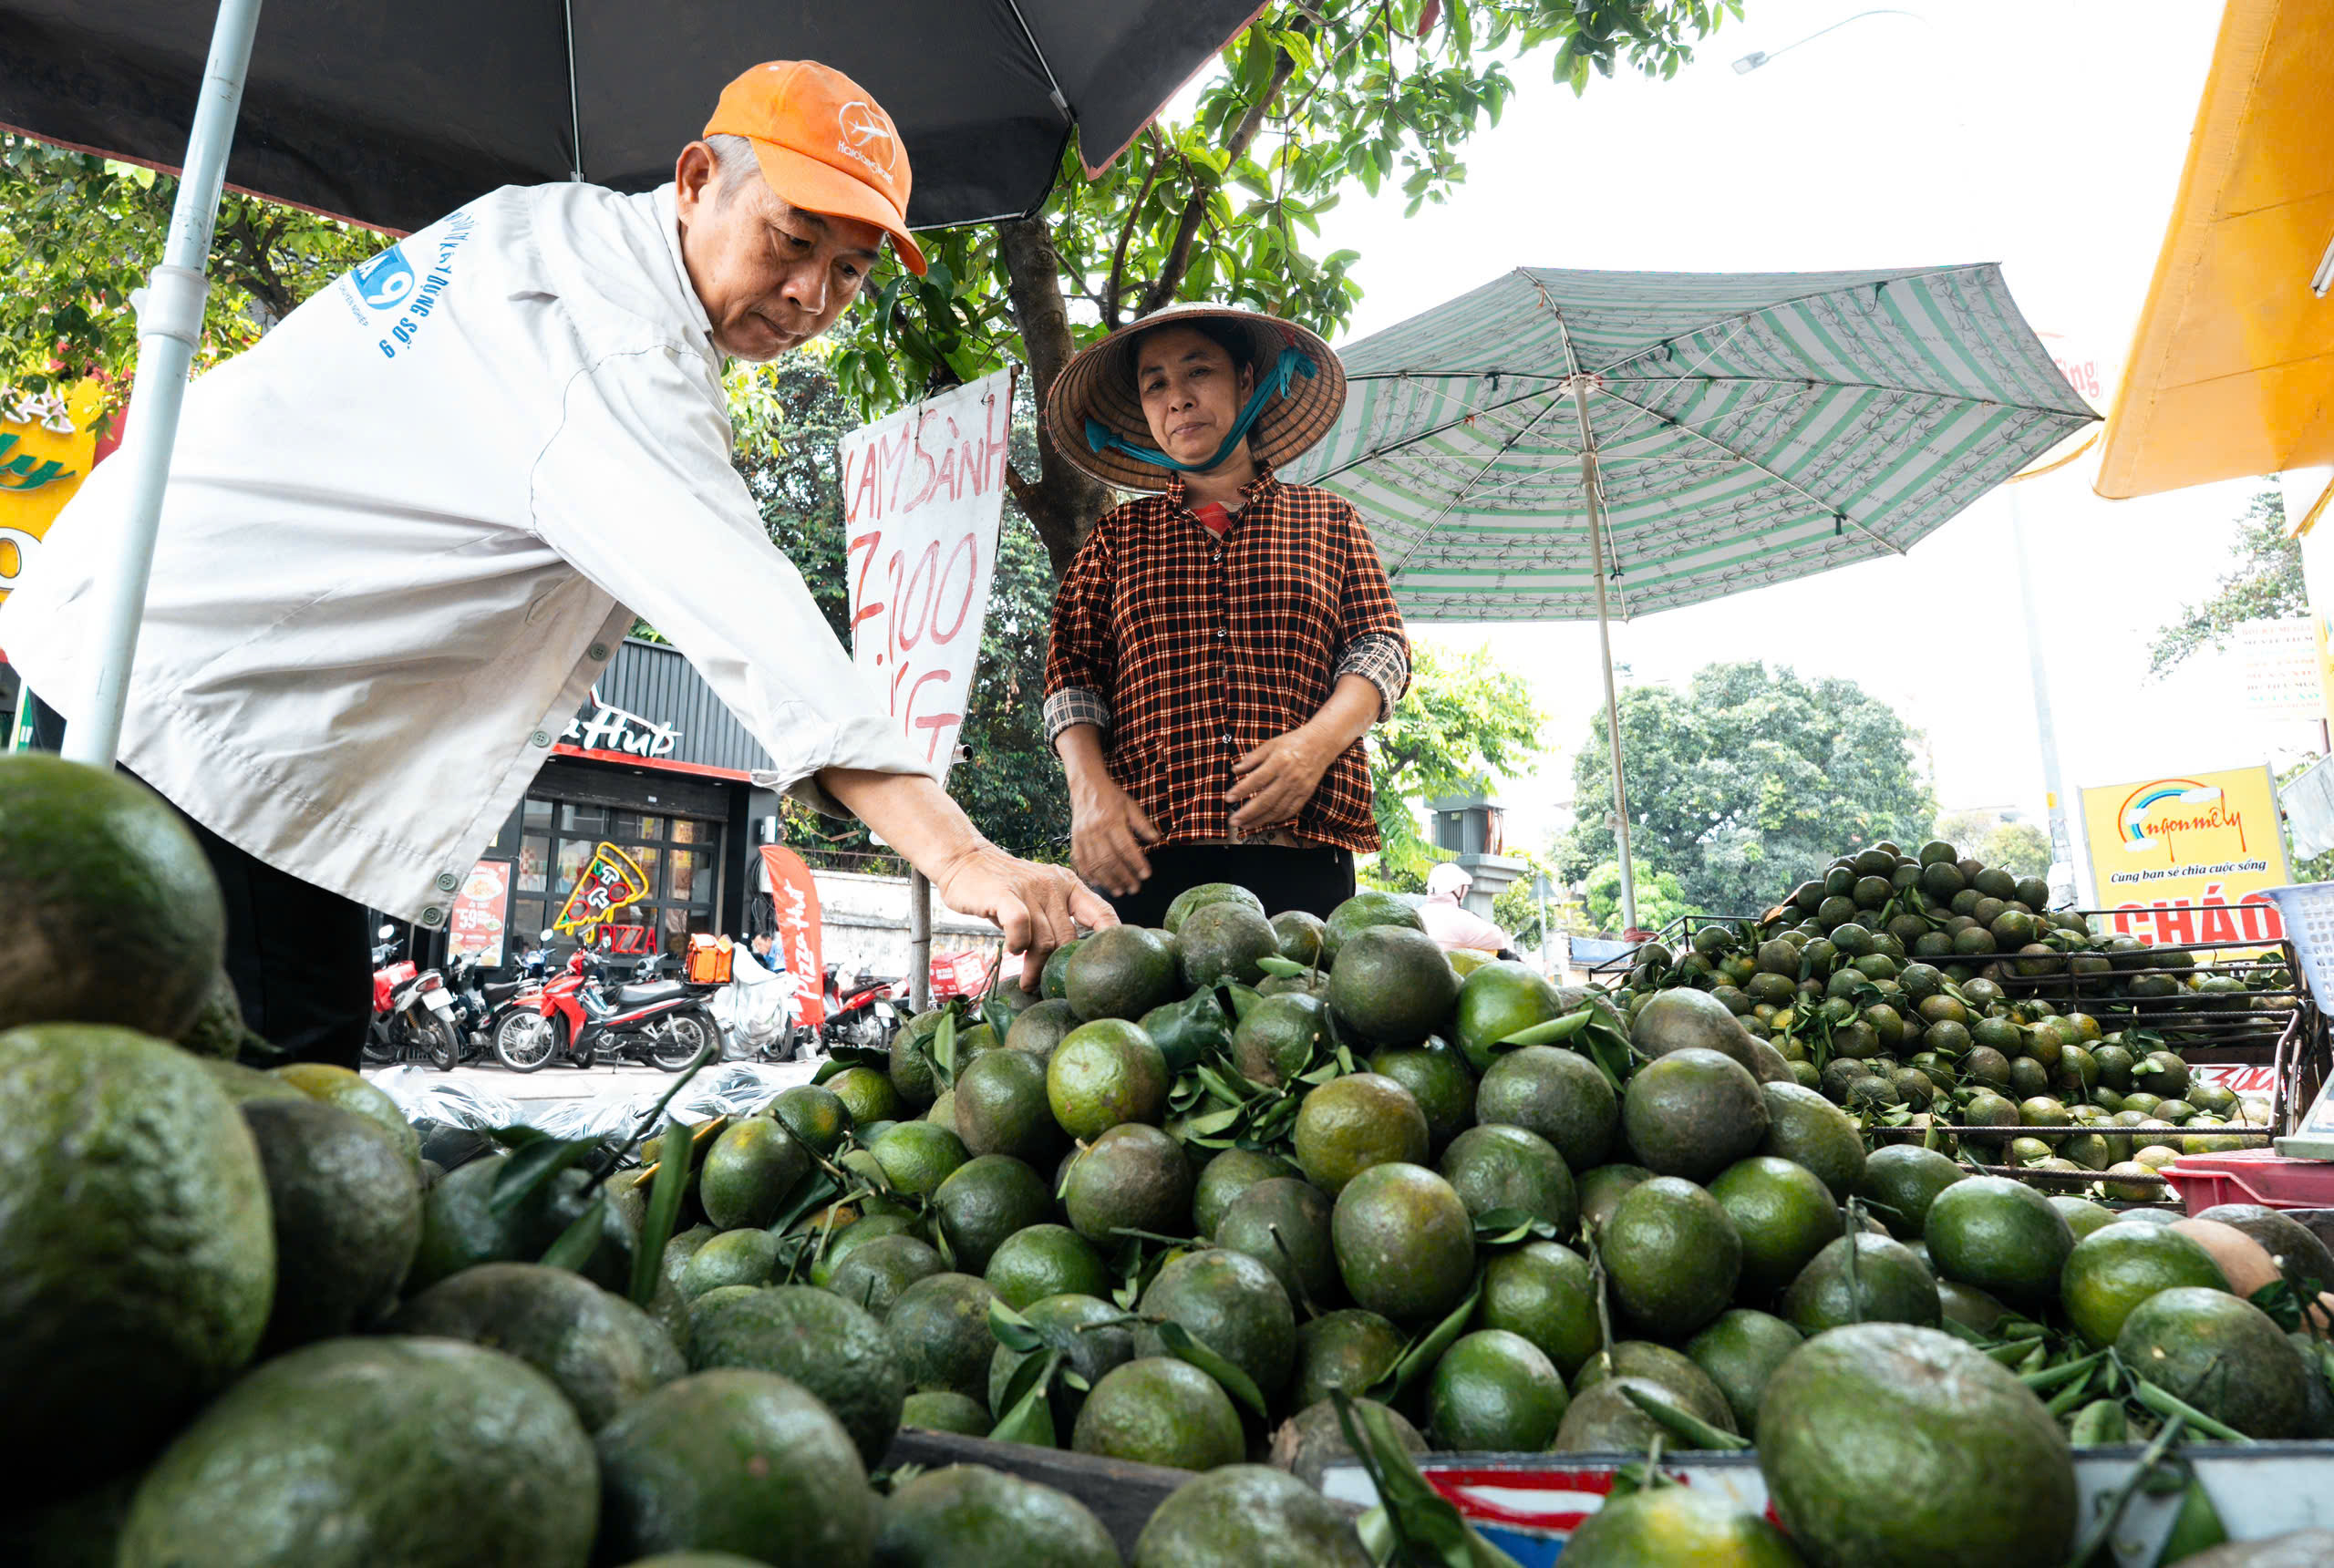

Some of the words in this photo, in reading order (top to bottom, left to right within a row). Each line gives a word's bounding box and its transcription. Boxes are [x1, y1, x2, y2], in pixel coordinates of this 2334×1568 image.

[582, 706, 683, 758] Hut
[2143, 870, 2164, 882] bạn
[2182, 864, 2206, 876] chia
[2209, 863, 2235, 875] cuộc
[2238, 858, 2267, 872] sống
[784, 878, 810, 931] Hut
[599, 924, 657, 954] PIZZA
